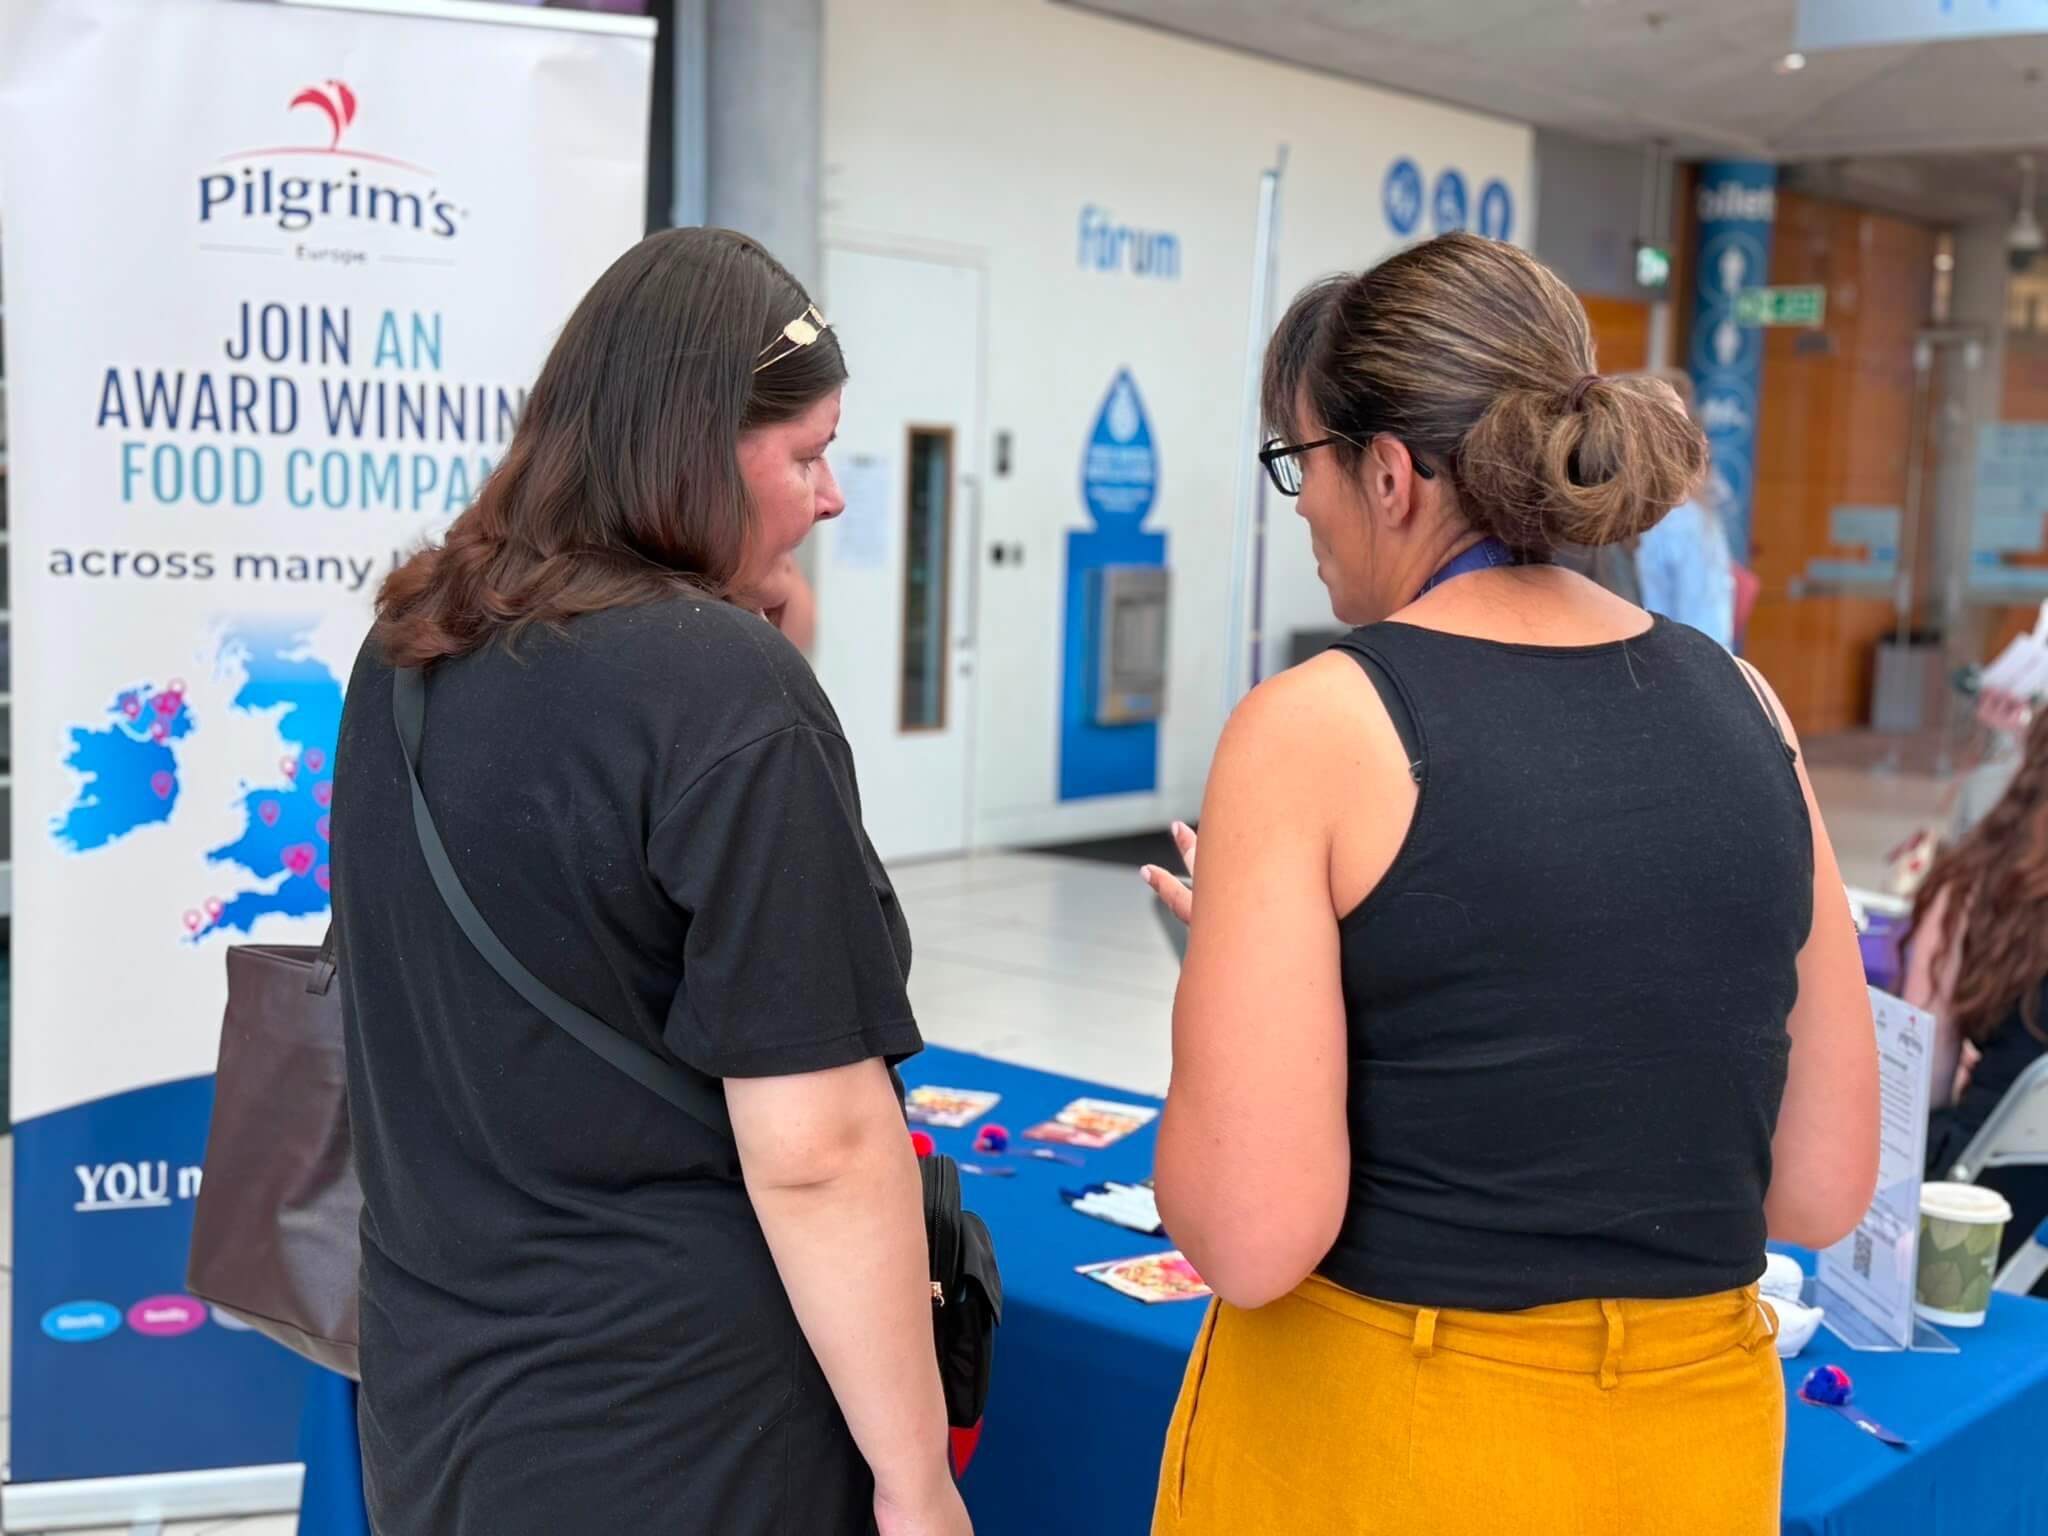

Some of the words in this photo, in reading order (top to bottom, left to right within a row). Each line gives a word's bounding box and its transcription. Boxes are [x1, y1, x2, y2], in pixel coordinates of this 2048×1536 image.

[200, 167, 457, 237] Pilgrim's
[226, 301, 350, 366] JOIN
[375, 309, 441, 371] AN
[98, 367, 299, 435] AWARD
[121, 442, 263, 506] FOOD
[49, 549, 215, 579] across
[234, 553, 373, 590] many
[75, 1160, 168, 1206] YOU
